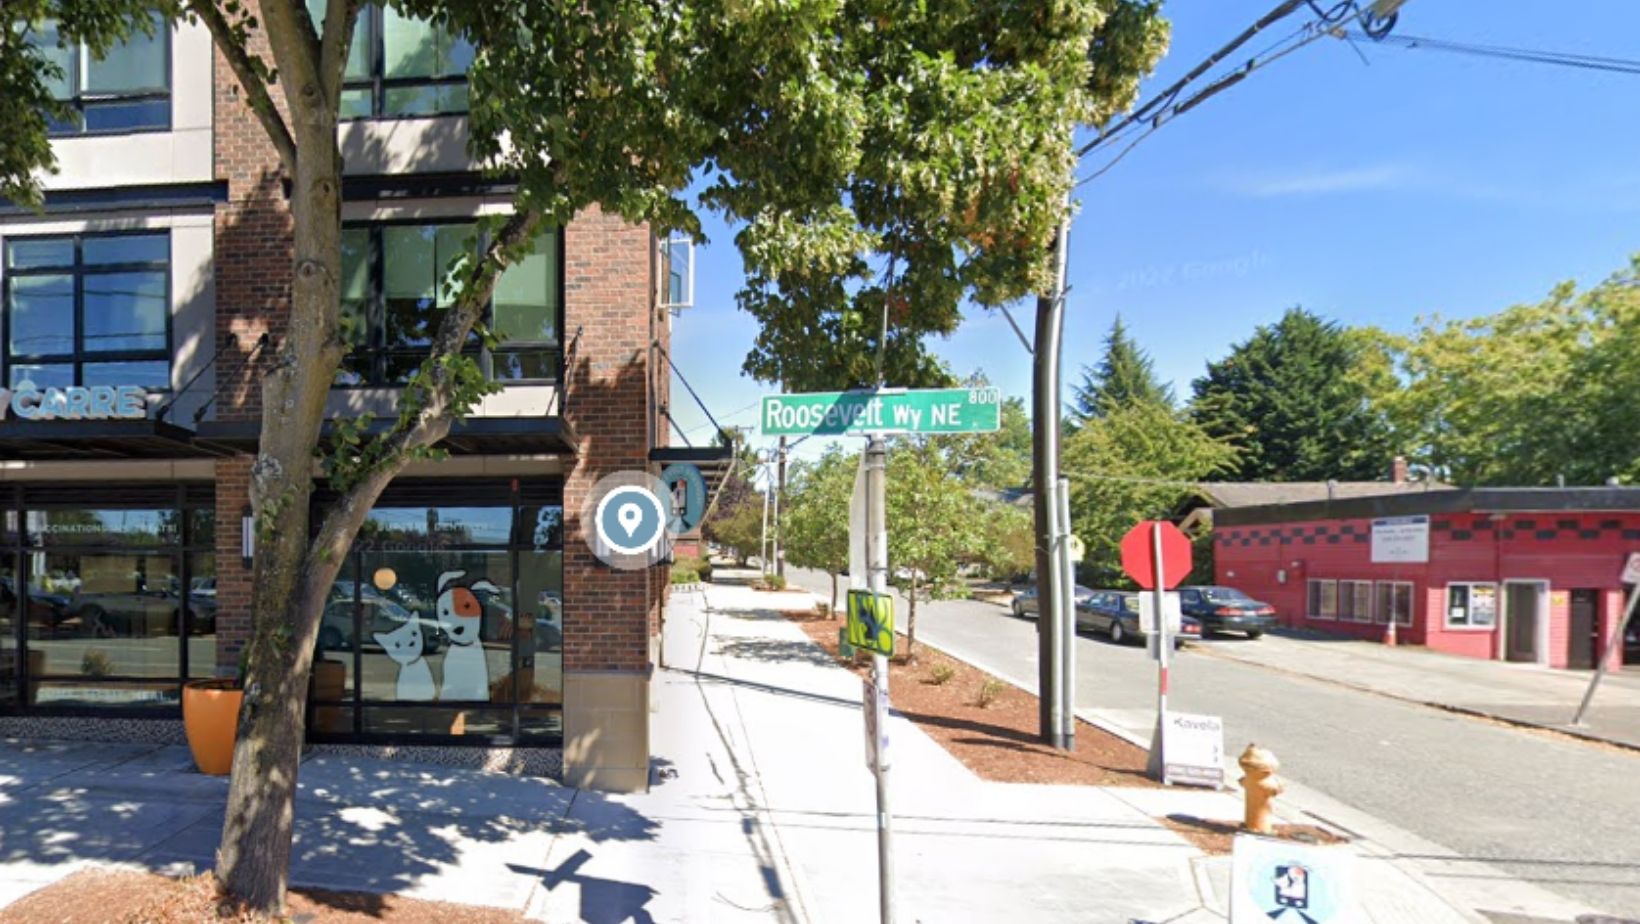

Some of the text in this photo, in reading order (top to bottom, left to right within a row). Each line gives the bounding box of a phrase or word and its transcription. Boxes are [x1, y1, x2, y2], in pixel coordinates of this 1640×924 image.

[968, 390, 998, 404] 800
[766, 398, 961, 430] Roosevelt Wy NE
